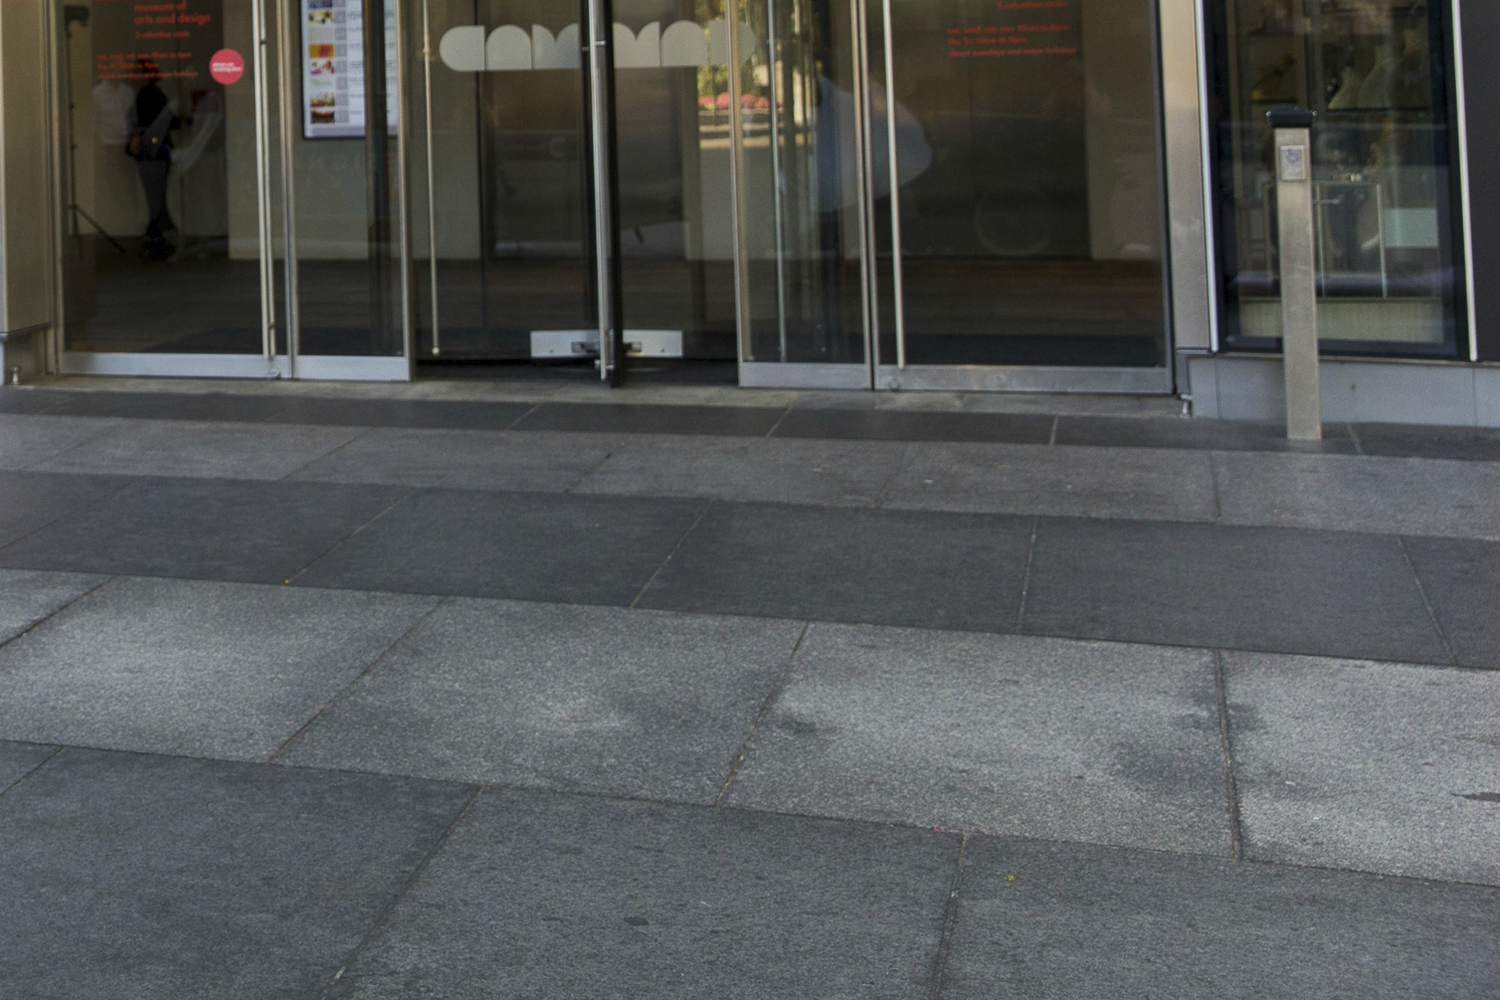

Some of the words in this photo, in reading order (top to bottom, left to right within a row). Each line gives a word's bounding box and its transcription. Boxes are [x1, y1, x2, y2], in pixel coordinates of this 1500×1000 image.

[176, 0, 187, 10] of
[134, 14, 154, 24] arts
[155, 13, 176, 24] and
[177, 11, 211, 26] design
